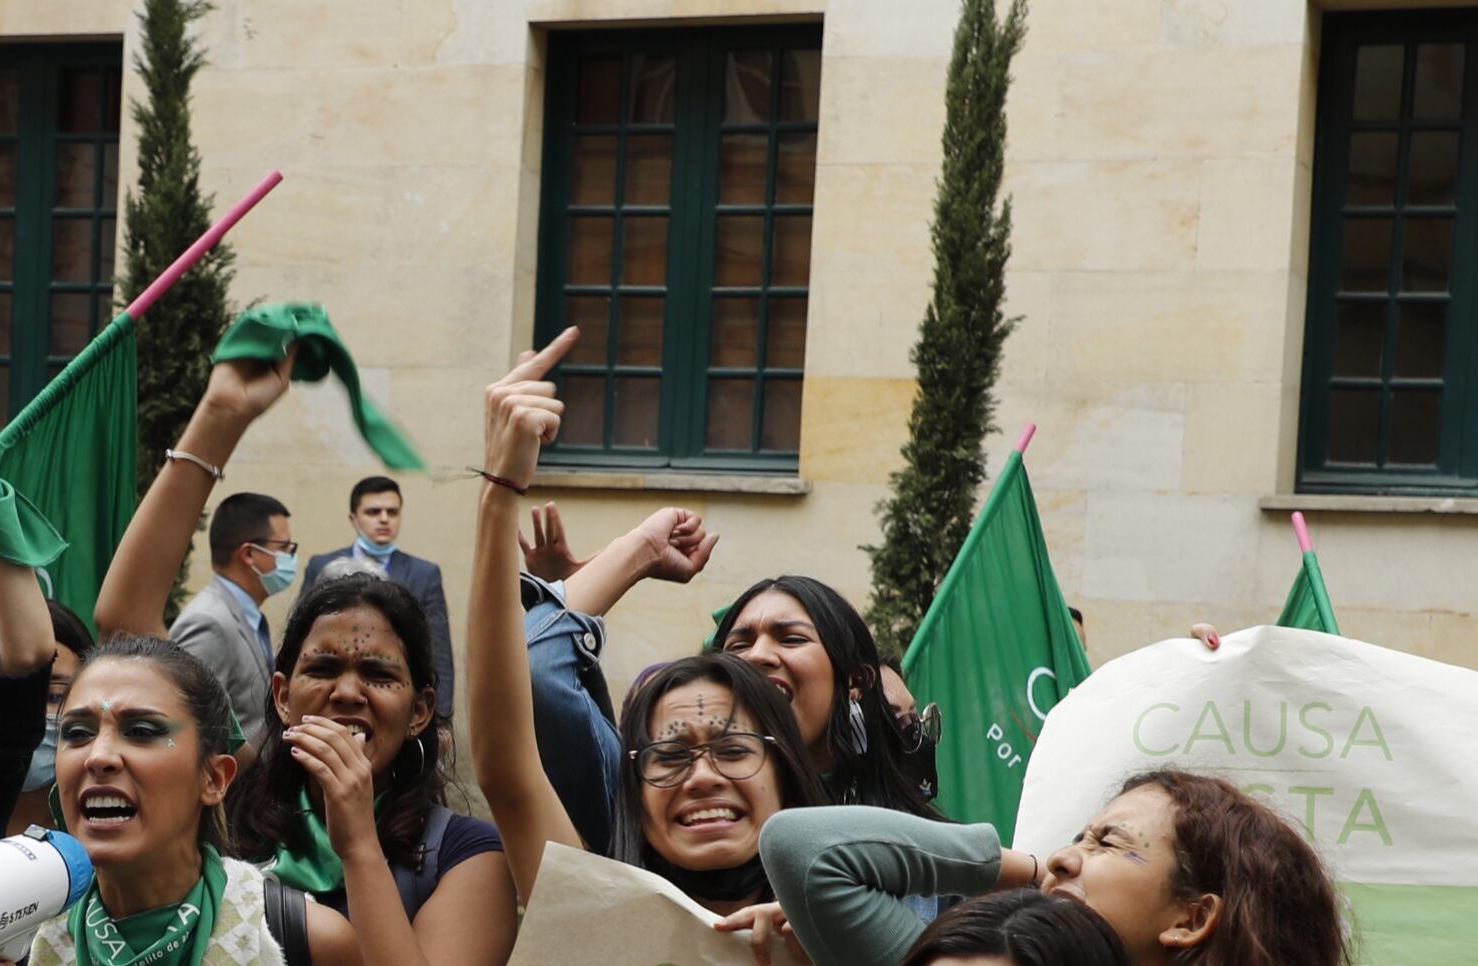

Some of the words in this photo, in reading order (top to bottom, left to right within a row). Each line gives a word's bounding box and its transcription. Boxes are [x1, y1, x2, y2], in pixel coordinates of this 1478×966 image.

[986, 723, 1022, 768] Por
[1132, 700, 1394, 761] CAUSA
[8, 901, 39, 923] STEREN
[167, 940, 179, 953] de
